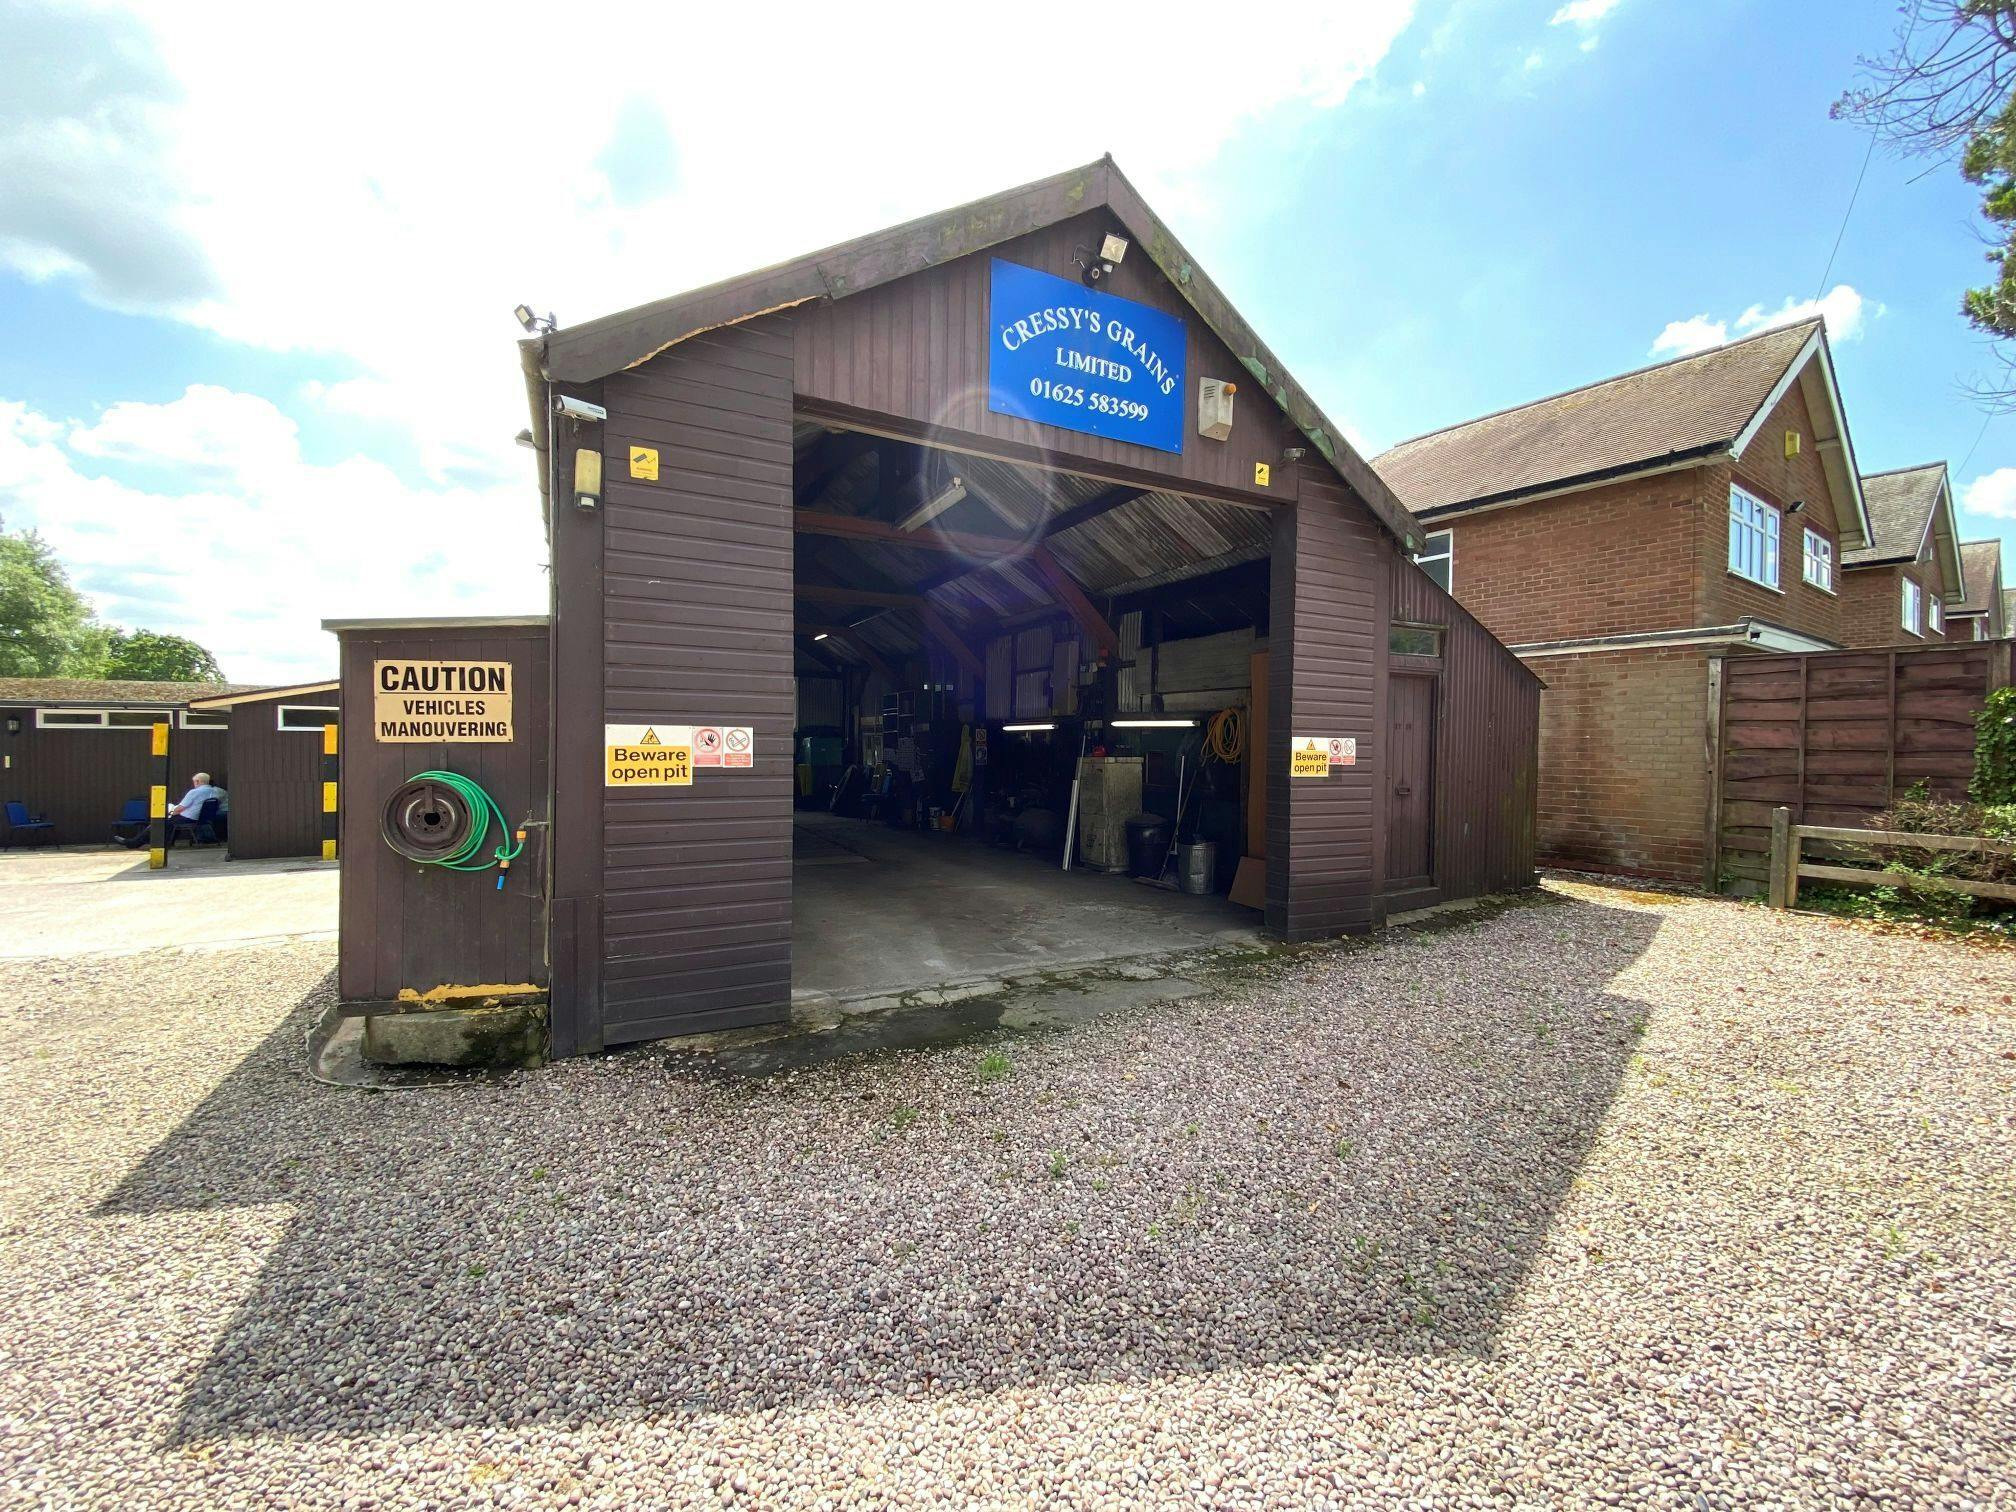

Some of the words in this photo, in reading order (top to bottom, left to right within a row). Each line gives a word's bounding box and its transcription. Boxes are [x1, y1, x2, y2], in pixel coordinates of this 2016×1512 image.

[1002, 306, 1101, 351] CRESSY'S
[1106, 320, 1176, 395] GRAINS
[1055, 347, 1132, 383] LIMITED
[1030, 377, 1084, 407] 01625
[1089, 392, 1149, 422] 583599
[381, 665, 505, 691] CAUTION
[403, 700, 486, 715] VEHICLES
[381, 721, 507, 737] MANOUVERING
[614, 748, 687, 762] Beware
[1295, 752, 1327, 761] Beware
[611, 766, 660, 782] open
[664, 764, 688, 781] pit
[1294, 764, 1315, 774] open
[1316, 763, 1327, 774] pit
